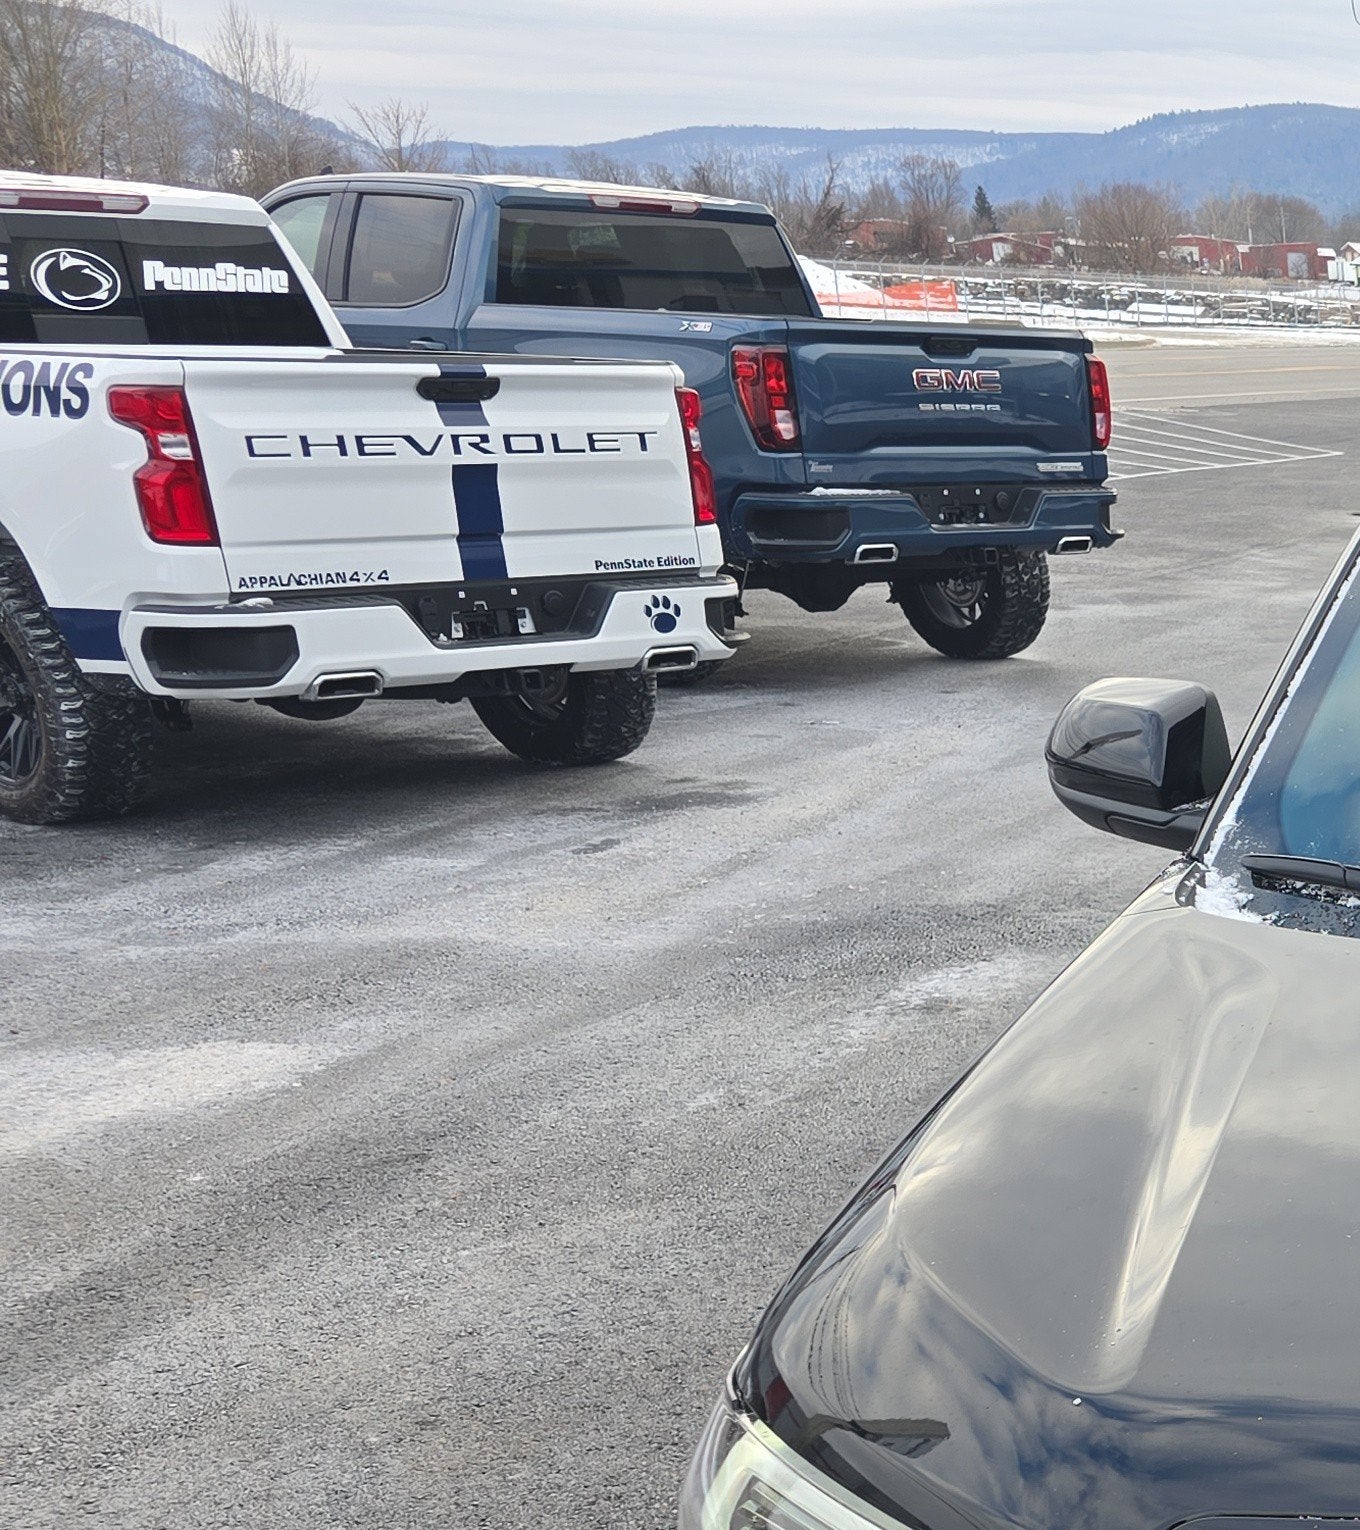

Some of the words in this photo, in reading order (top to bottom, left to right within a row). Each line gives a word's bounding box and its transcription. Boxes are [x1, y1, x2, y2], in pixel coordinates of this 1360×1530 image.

[143, 260, 289, 293] PennState
[912, 369, 1000, 391] GMC
[245, 432, 657, 458] CHEVROLET
[594, 560, 654, 571] PennState
[656, 555, 696, 568] Edition
